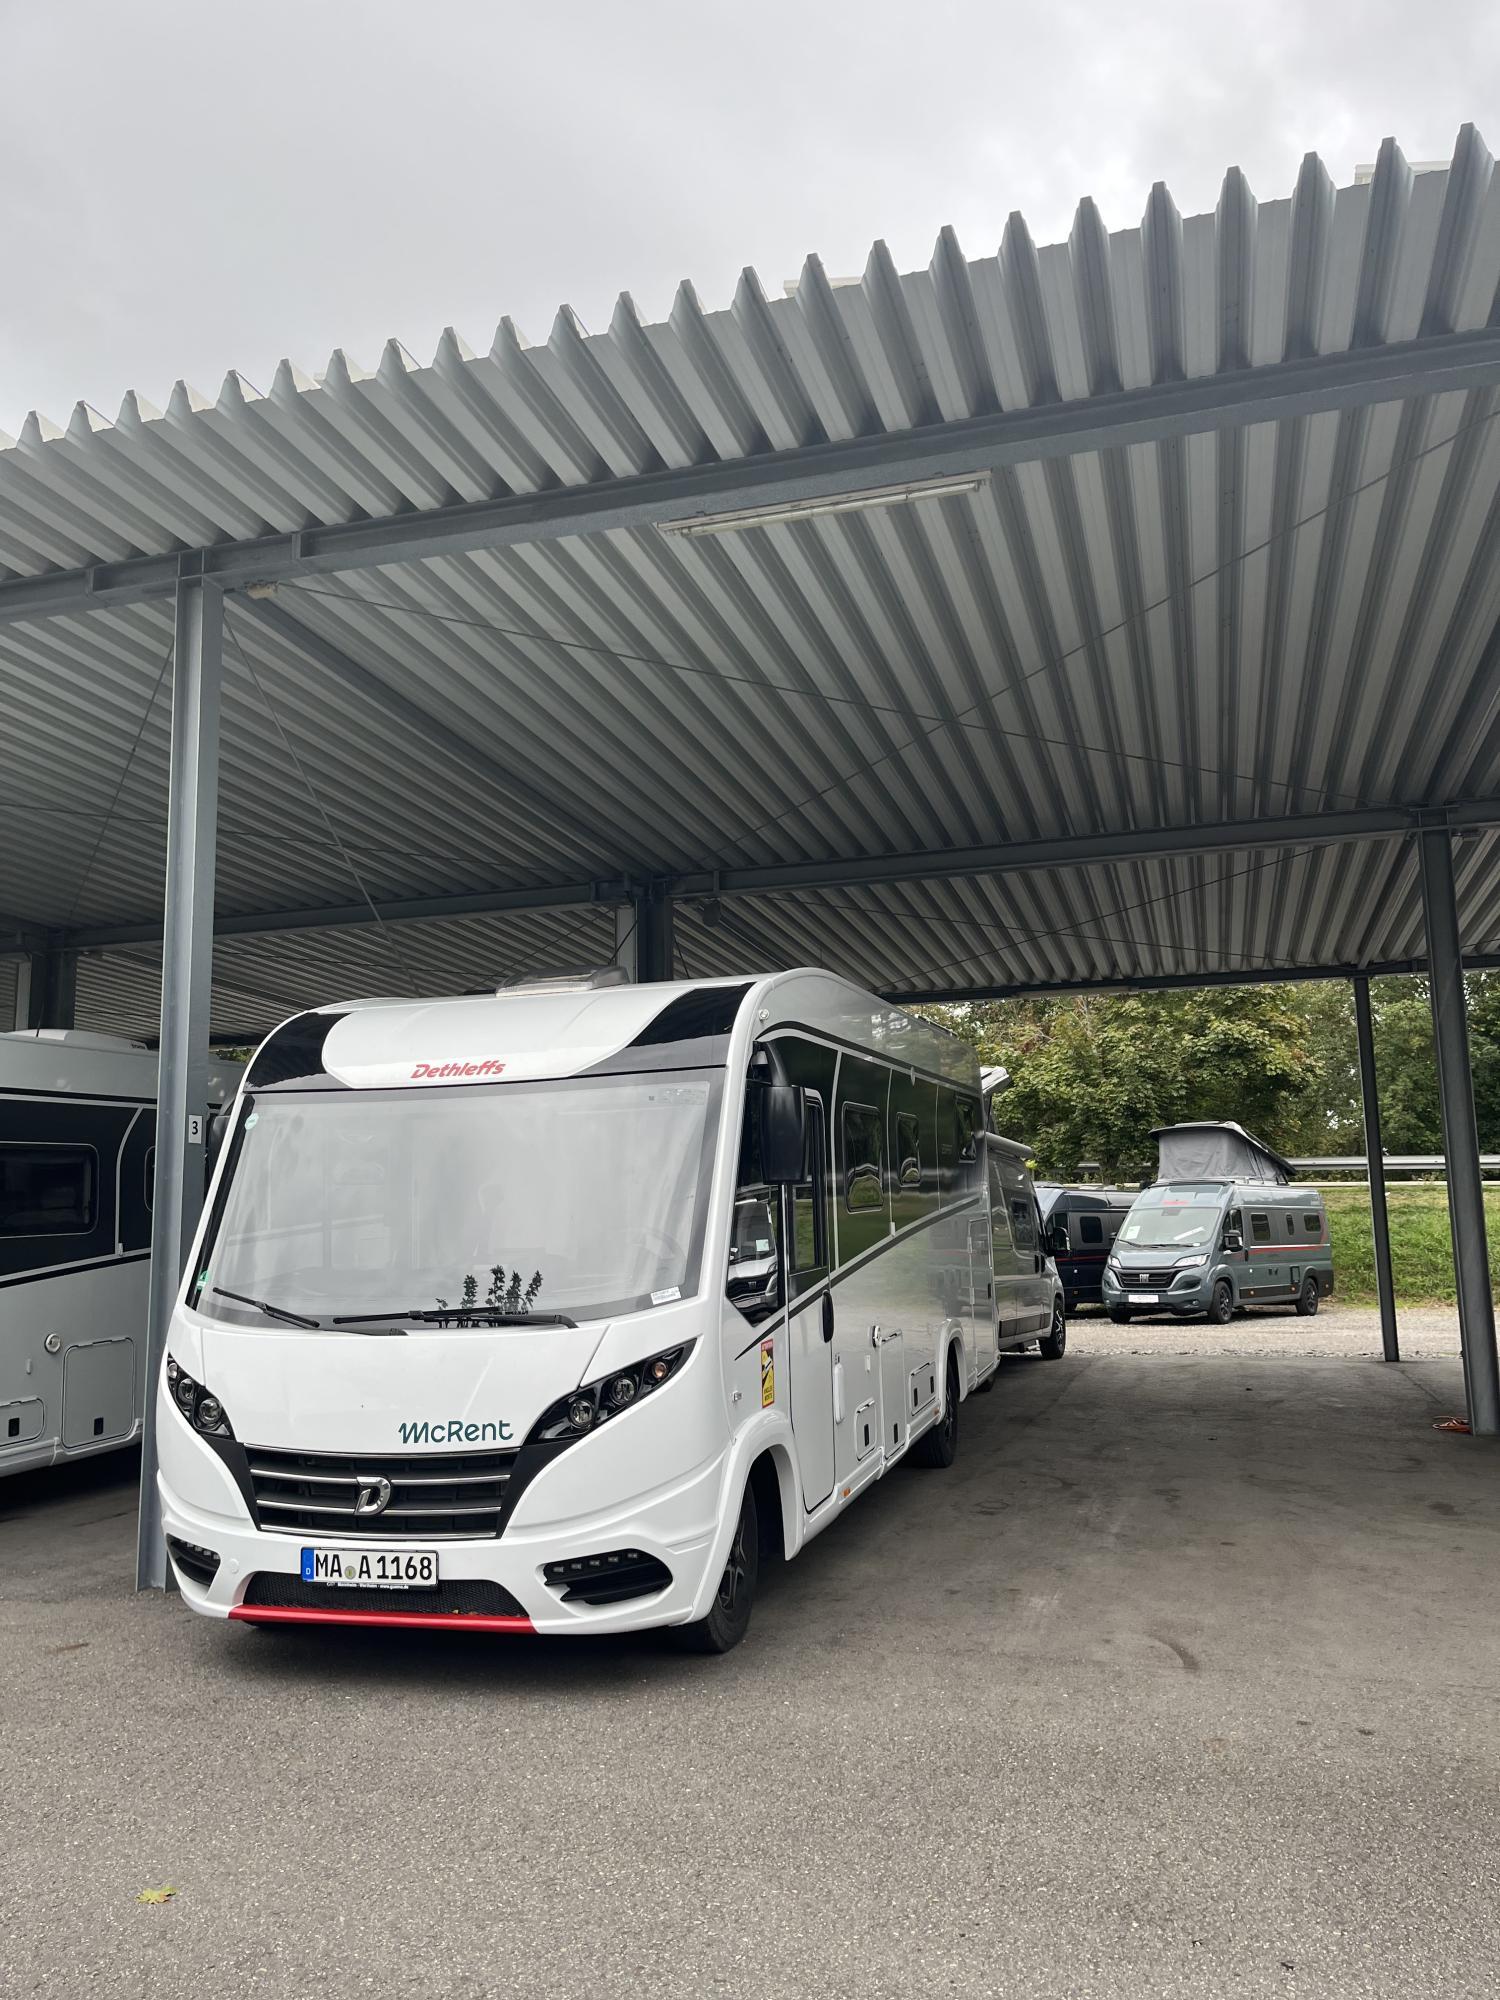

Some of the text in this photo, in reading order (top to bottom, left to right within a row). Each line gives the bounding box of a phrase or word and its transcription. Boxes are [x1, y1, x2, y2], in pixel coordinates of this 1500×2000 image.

[410, 1060, 506, 1079] Dethleffs
[191, 1120, 199, 1135] 3
[398, 1419, 514, 1444] McRent
[315, 1553, 342, 1577] MA
[376, 1555, 433, 1580] 1168
